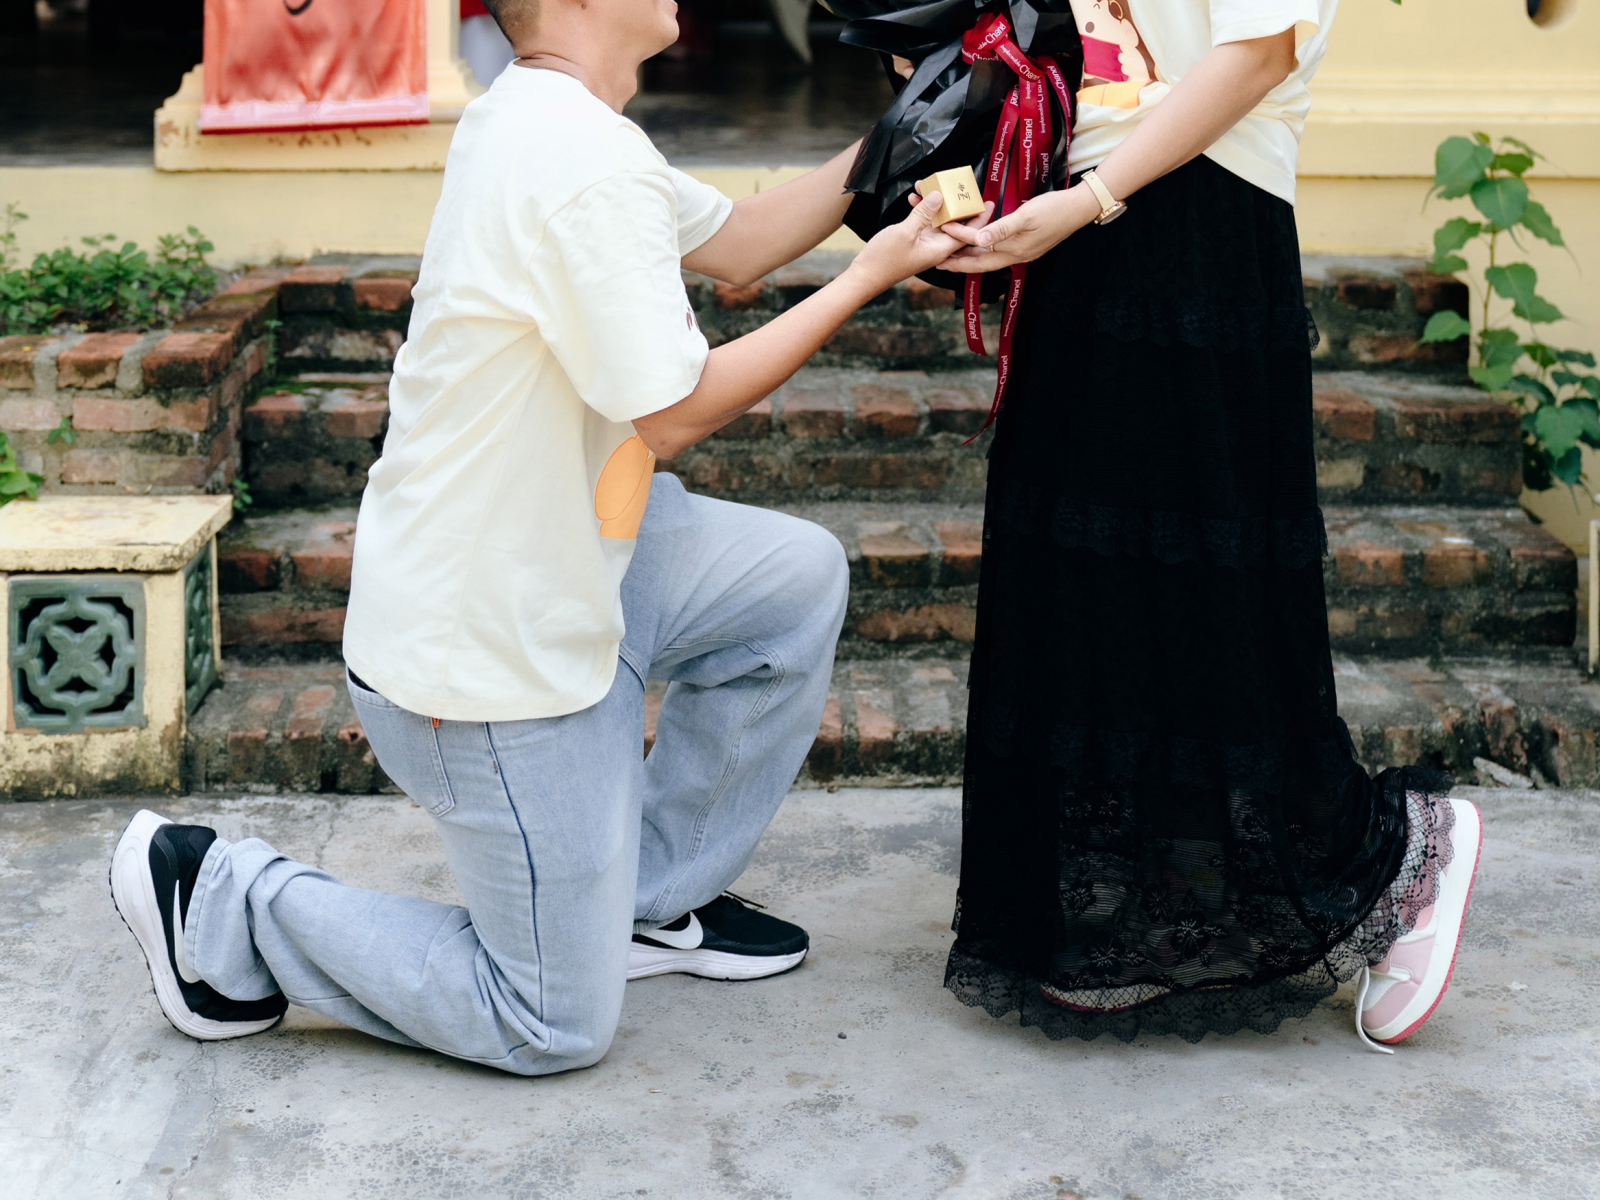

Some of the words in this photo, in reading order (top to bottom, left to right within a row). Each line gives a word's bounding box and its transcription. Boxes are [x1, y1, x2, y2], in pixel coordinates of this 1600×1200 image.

[1047, 65, 1065, 90] Chanel
[1022, 118, 1033, 149] Chanel
[990, 151, 1005, 182] Chanel
[1010, 279, 1021, 308] Chanel
[968, 312, 979, 340] Chanel
[1000, 355, 1008, 385] Chanel
